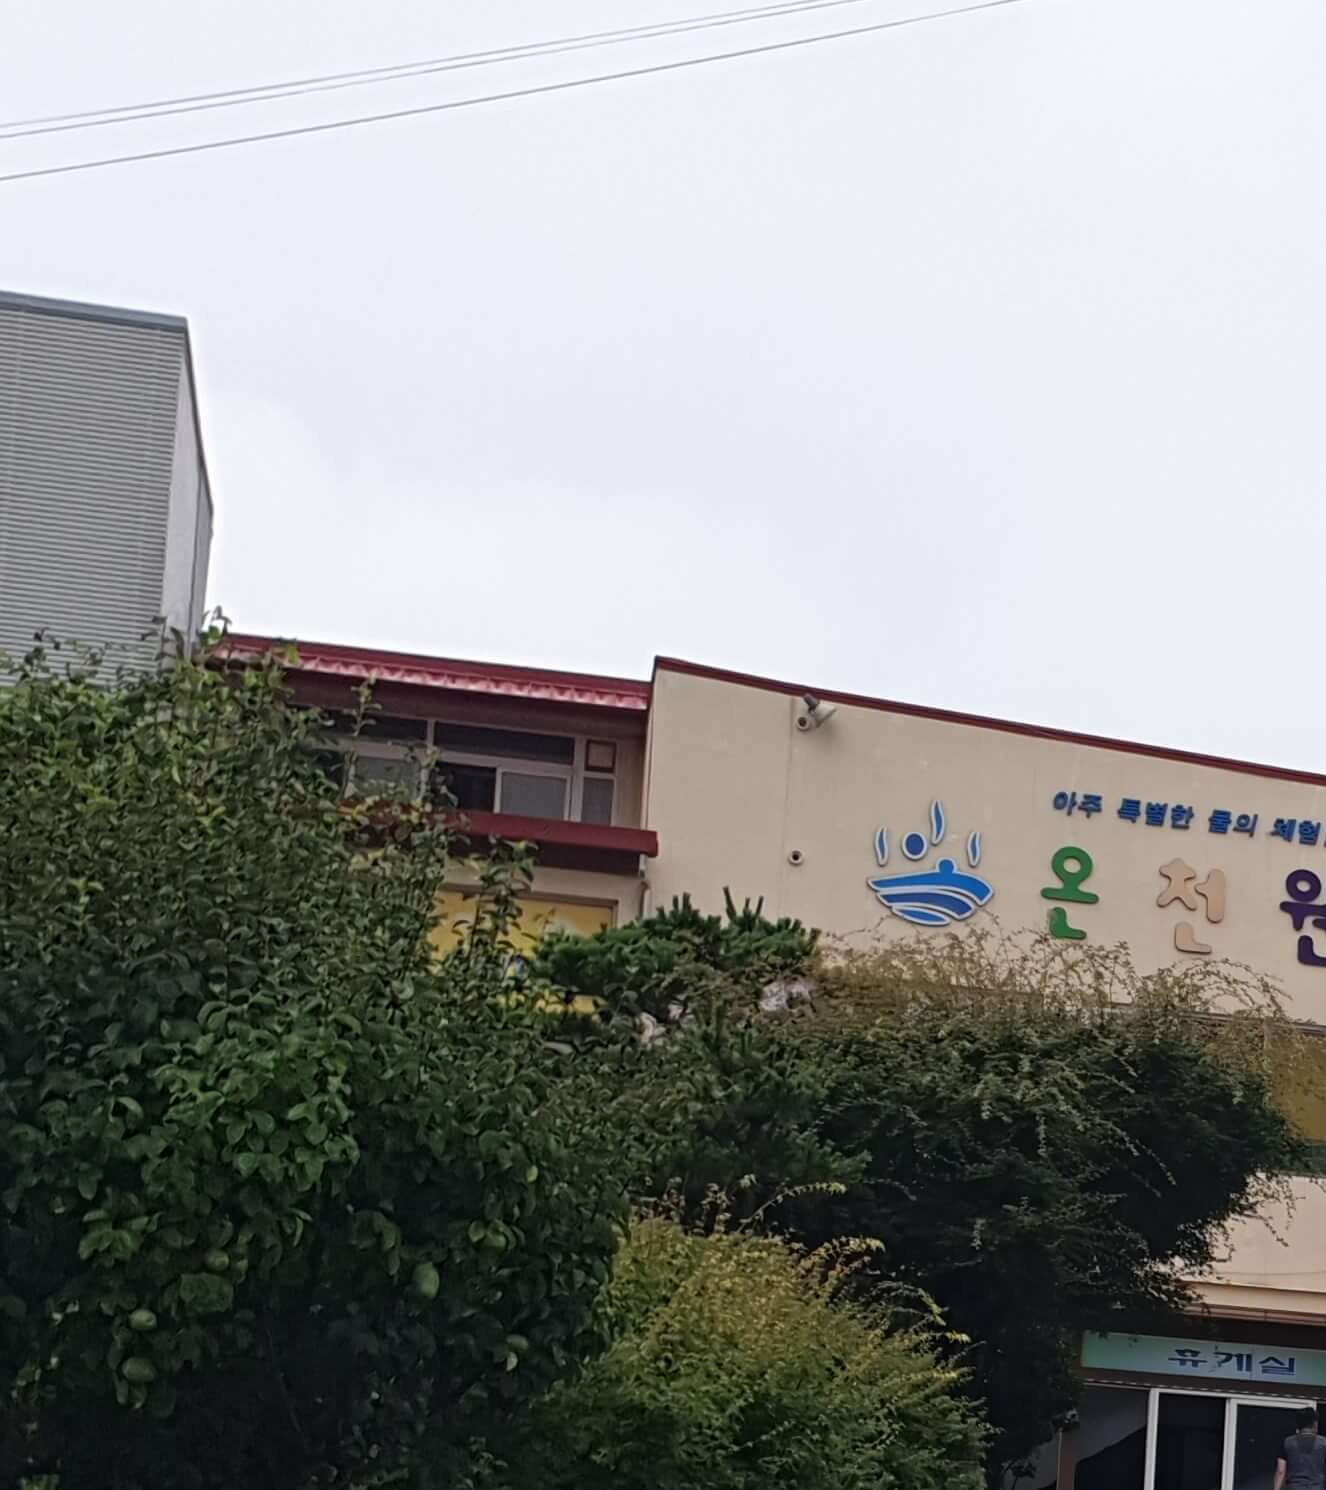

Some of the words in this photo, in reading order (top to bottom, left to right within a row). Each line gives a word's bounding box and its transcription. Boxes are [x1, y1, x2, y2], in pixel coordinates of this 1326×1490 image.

[1053, 791, 1103, 818] 아주
[1117, 798, 1195, 830] 특별한
[1208, 809, 1259, 838] 물의
